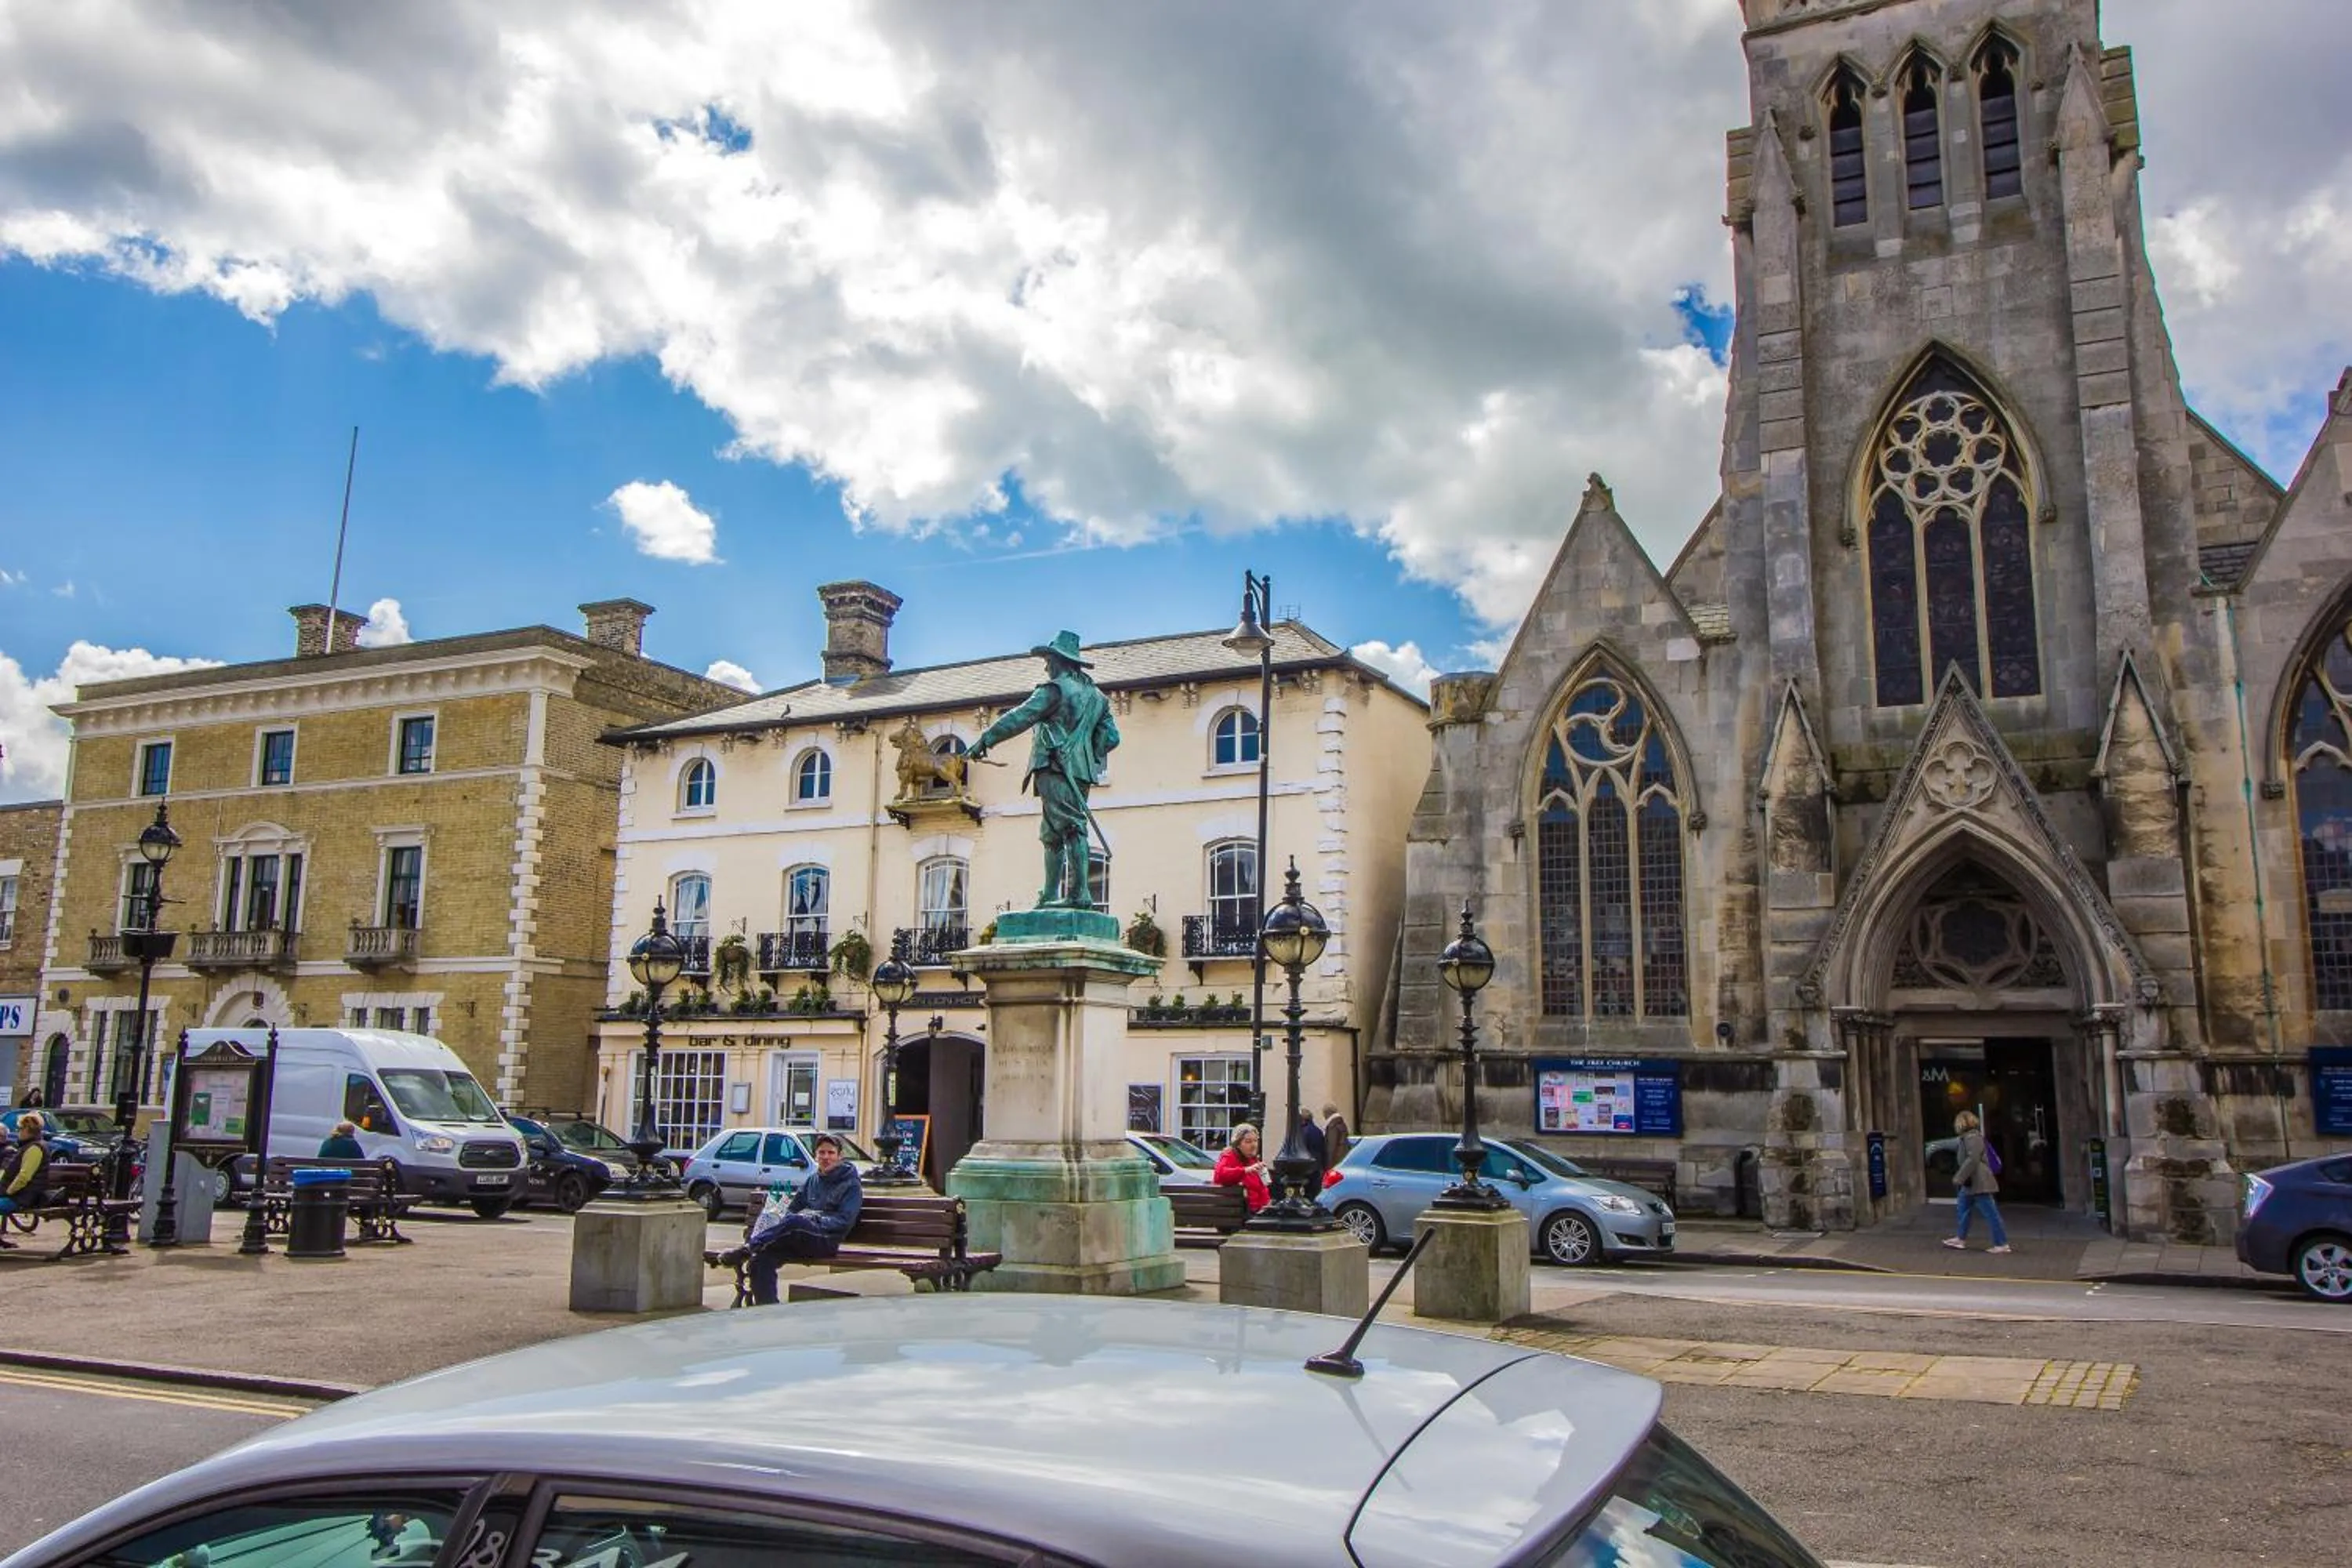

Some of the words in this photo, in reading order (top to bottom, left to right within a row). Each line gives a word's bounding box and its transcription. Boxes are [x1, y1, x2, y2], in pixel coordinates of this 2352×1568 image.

[688, 1034, 717, 1047] bar
[722, 1034, 735, 1047] &
[743, 1034, 791, 1050] dining
